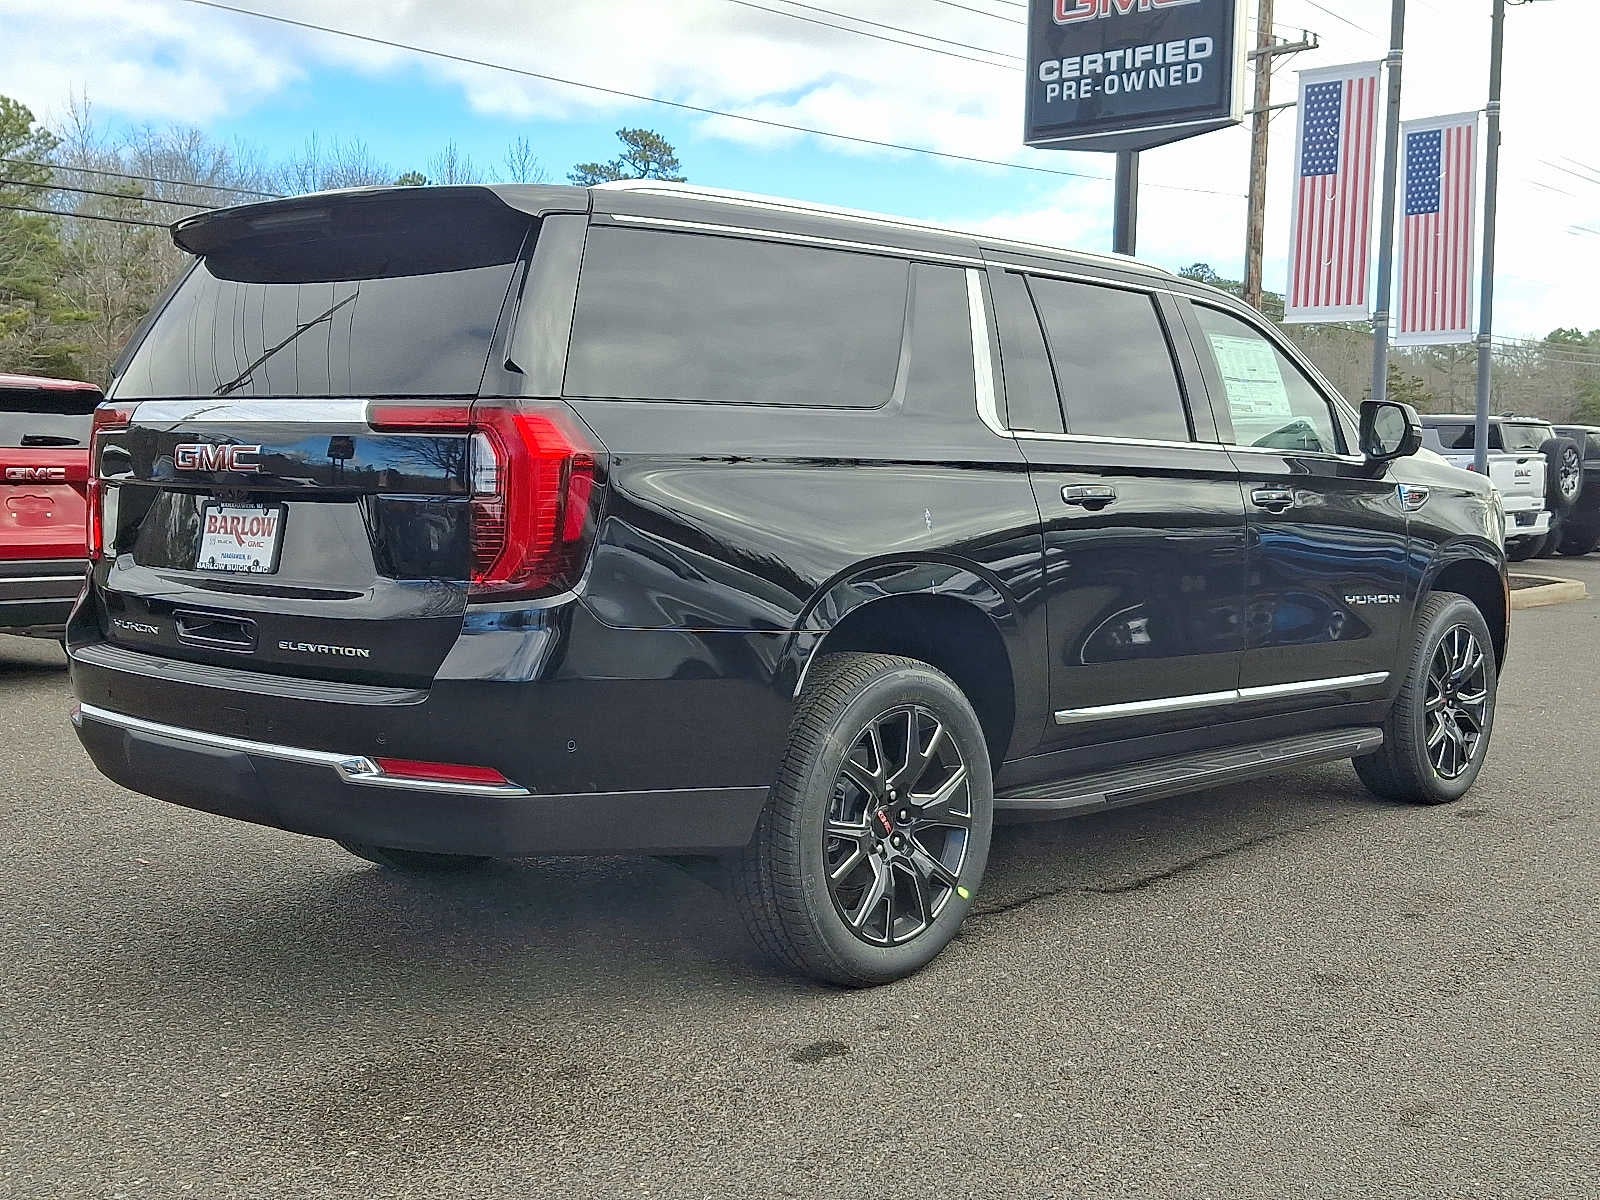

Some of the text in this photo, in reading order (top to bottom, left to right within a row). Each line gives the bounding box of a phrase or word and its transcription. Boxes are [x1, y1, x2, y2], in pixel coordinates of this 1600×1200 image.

[1039, 37, 1213, 81] CERTIFIED
[1046, 63, 1203, 103] PRE-OWNED
[174, 443, 262, 472] GMC
[5, 467, 66, 480] GMC
[206, 514, 276, 547] BARLOW
[197, 561, 269, 573] BARLOW BUICK GMC
[1344, 594, 1401, 605] YUKON
[112, 618, 159, 635] YUKON
[278, 640, 370, 658] ELEVATION
